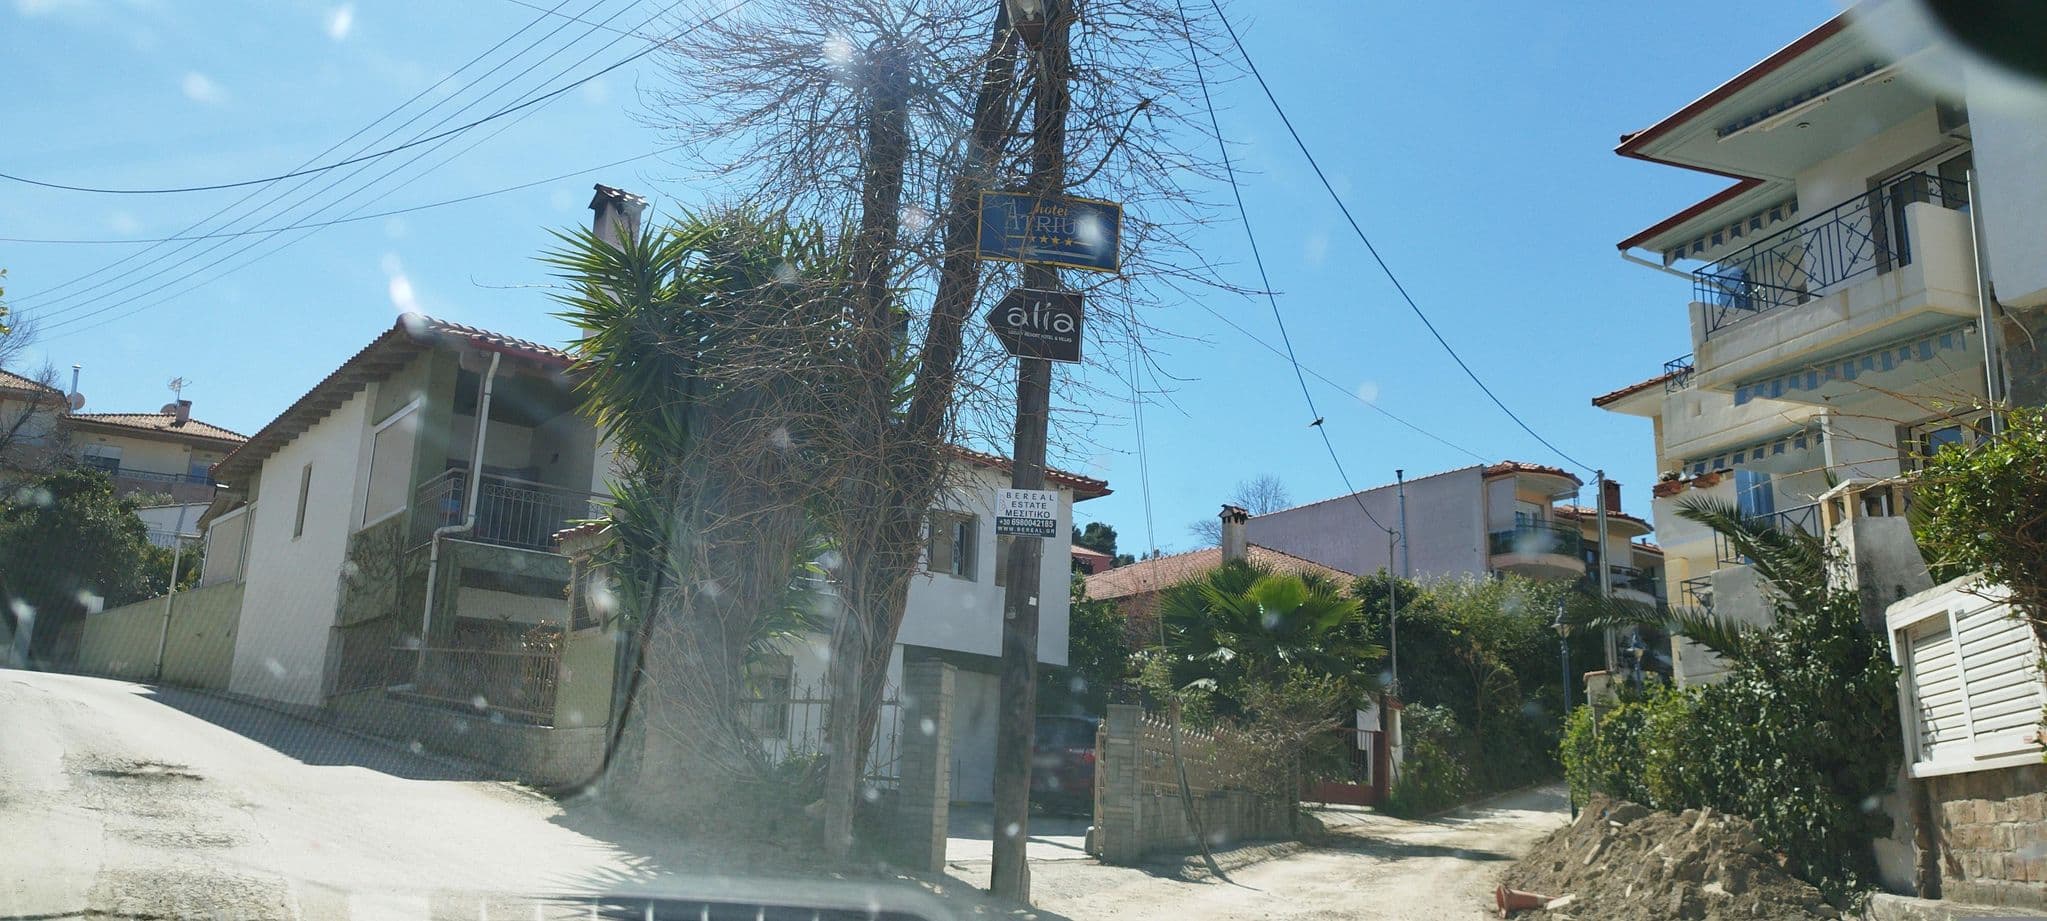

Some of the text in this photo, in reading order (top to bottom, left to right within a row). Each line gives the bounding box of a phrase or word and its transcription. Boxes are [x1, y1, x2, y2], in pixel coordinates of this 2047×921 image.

[1006, 198, 1093, 239] ATRIU
[1006, 492, 1054, 501] BEREAL
[1011, 501, 1047, 509] ESTATE
[1005, 509, 1050, 519] ΜΕΣΙΤΙΚΟ
